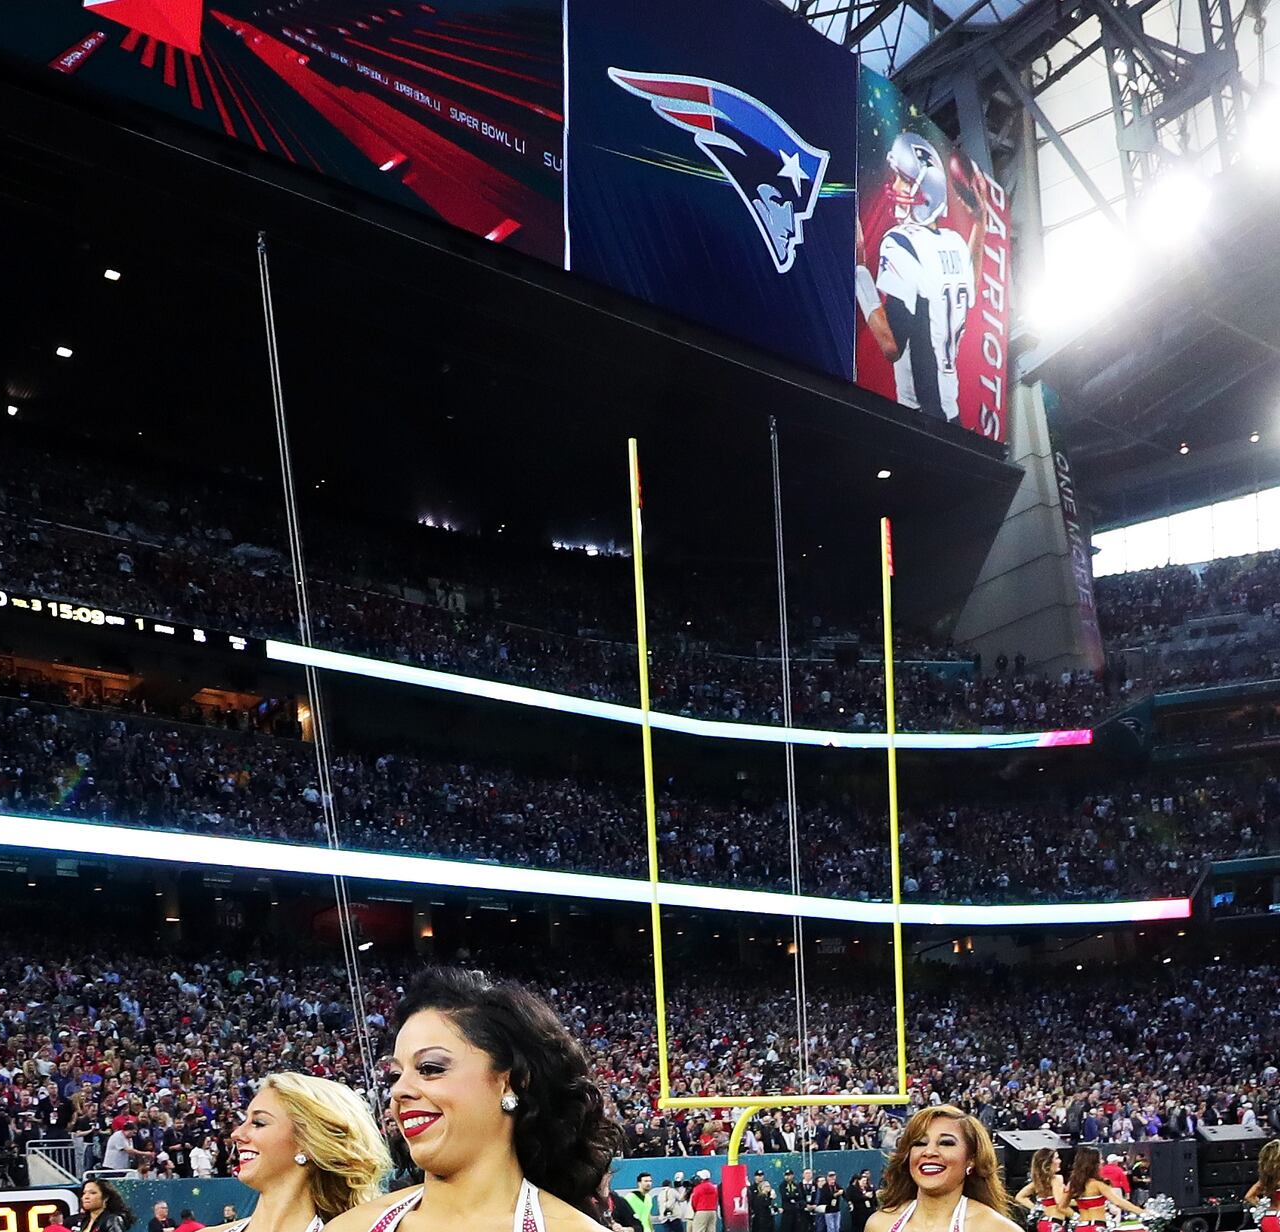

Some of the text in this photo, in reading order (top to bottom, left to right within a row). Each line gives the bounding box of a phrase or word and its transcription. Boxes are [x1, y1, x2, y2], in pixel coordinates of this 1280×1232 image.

[449, 107, 526, 154] SUPER BOWL LI
[978, 175, 1007, 442] PATRIOTS
